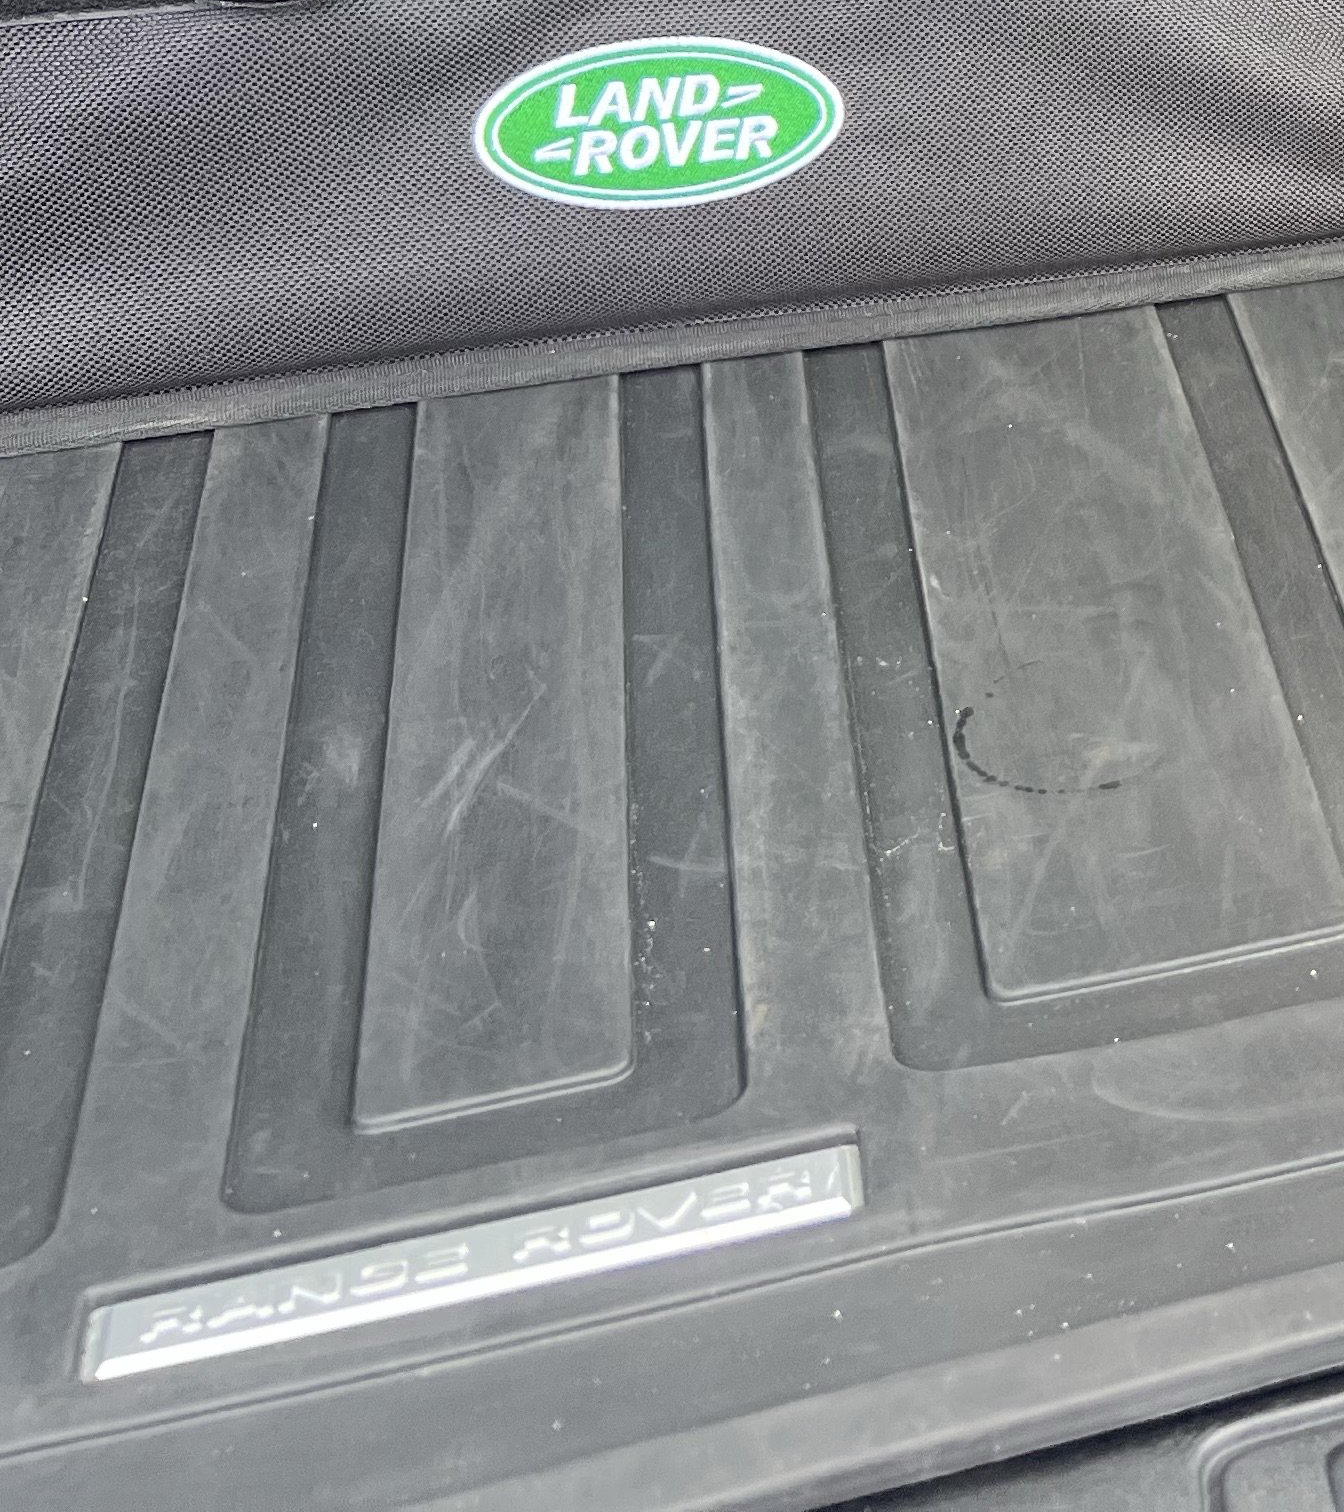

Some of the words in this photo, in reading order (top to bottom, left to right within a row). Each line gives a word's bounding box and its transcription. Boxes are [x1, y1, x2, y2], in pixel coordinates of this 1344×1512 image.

[555, 73, 722, 128] LAND
[572, 115, 779, 176] ROVER
[139, 1240, 471, 1344] RANGE
[512, 1167, 812, 1264] ROVER
